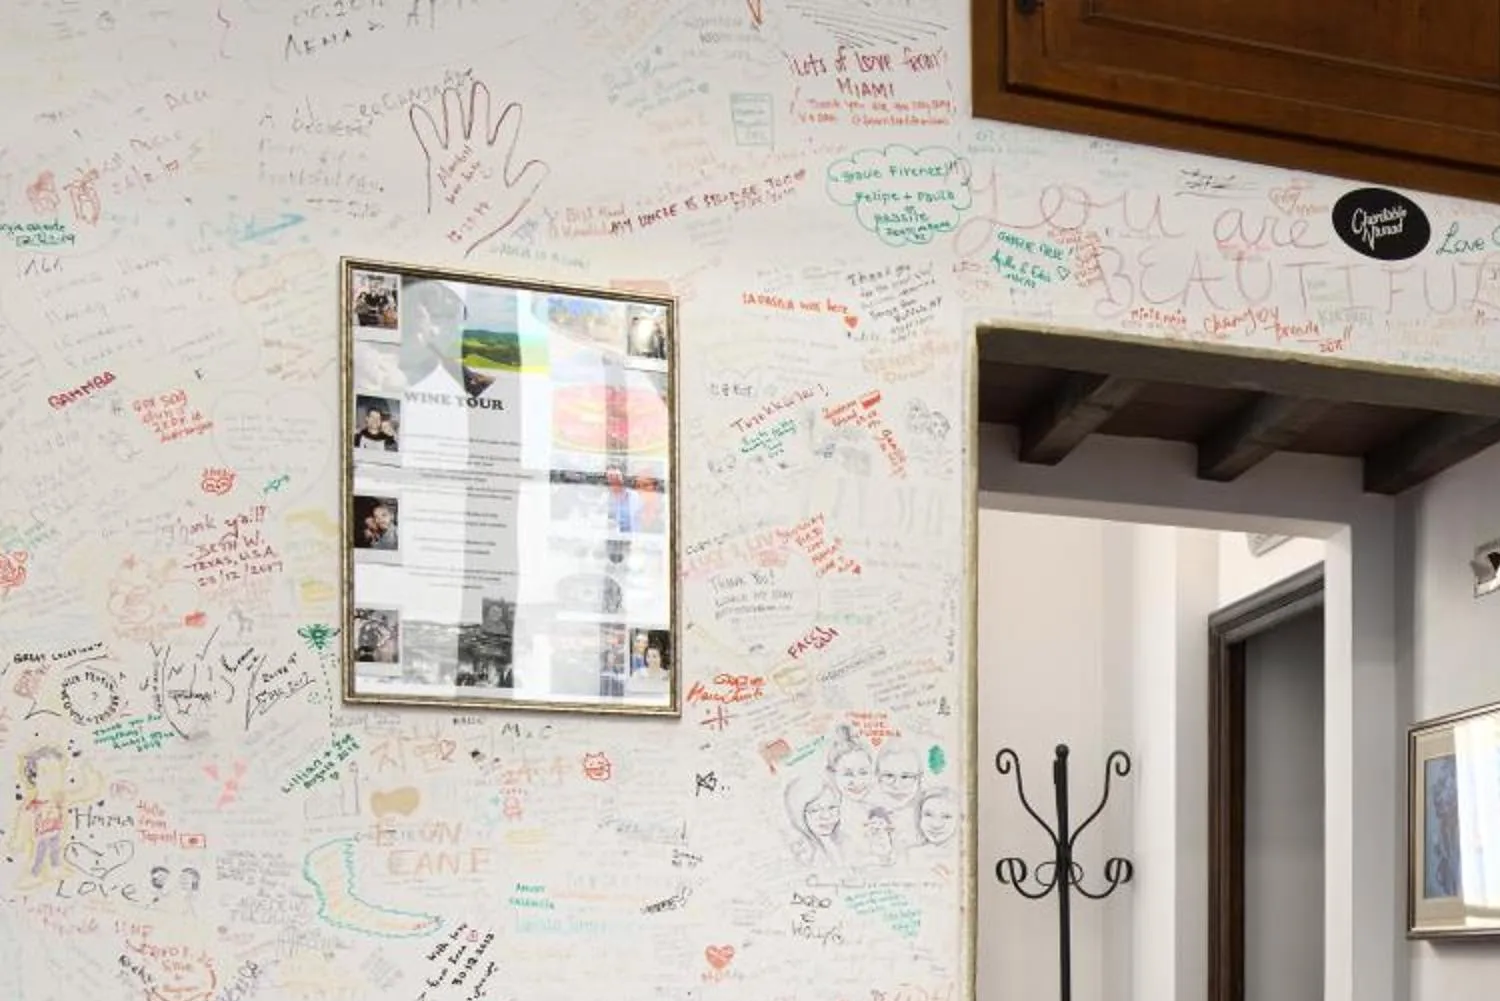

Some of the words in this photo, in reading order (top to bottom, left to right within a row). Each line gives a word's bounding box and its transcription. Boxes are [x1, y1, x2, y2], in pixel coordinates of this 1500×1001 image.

[836, 78, 895, 98] MIAMI
[1436, 221, 1485, 256] Love
[454, 395, 506, 412] TOUR
